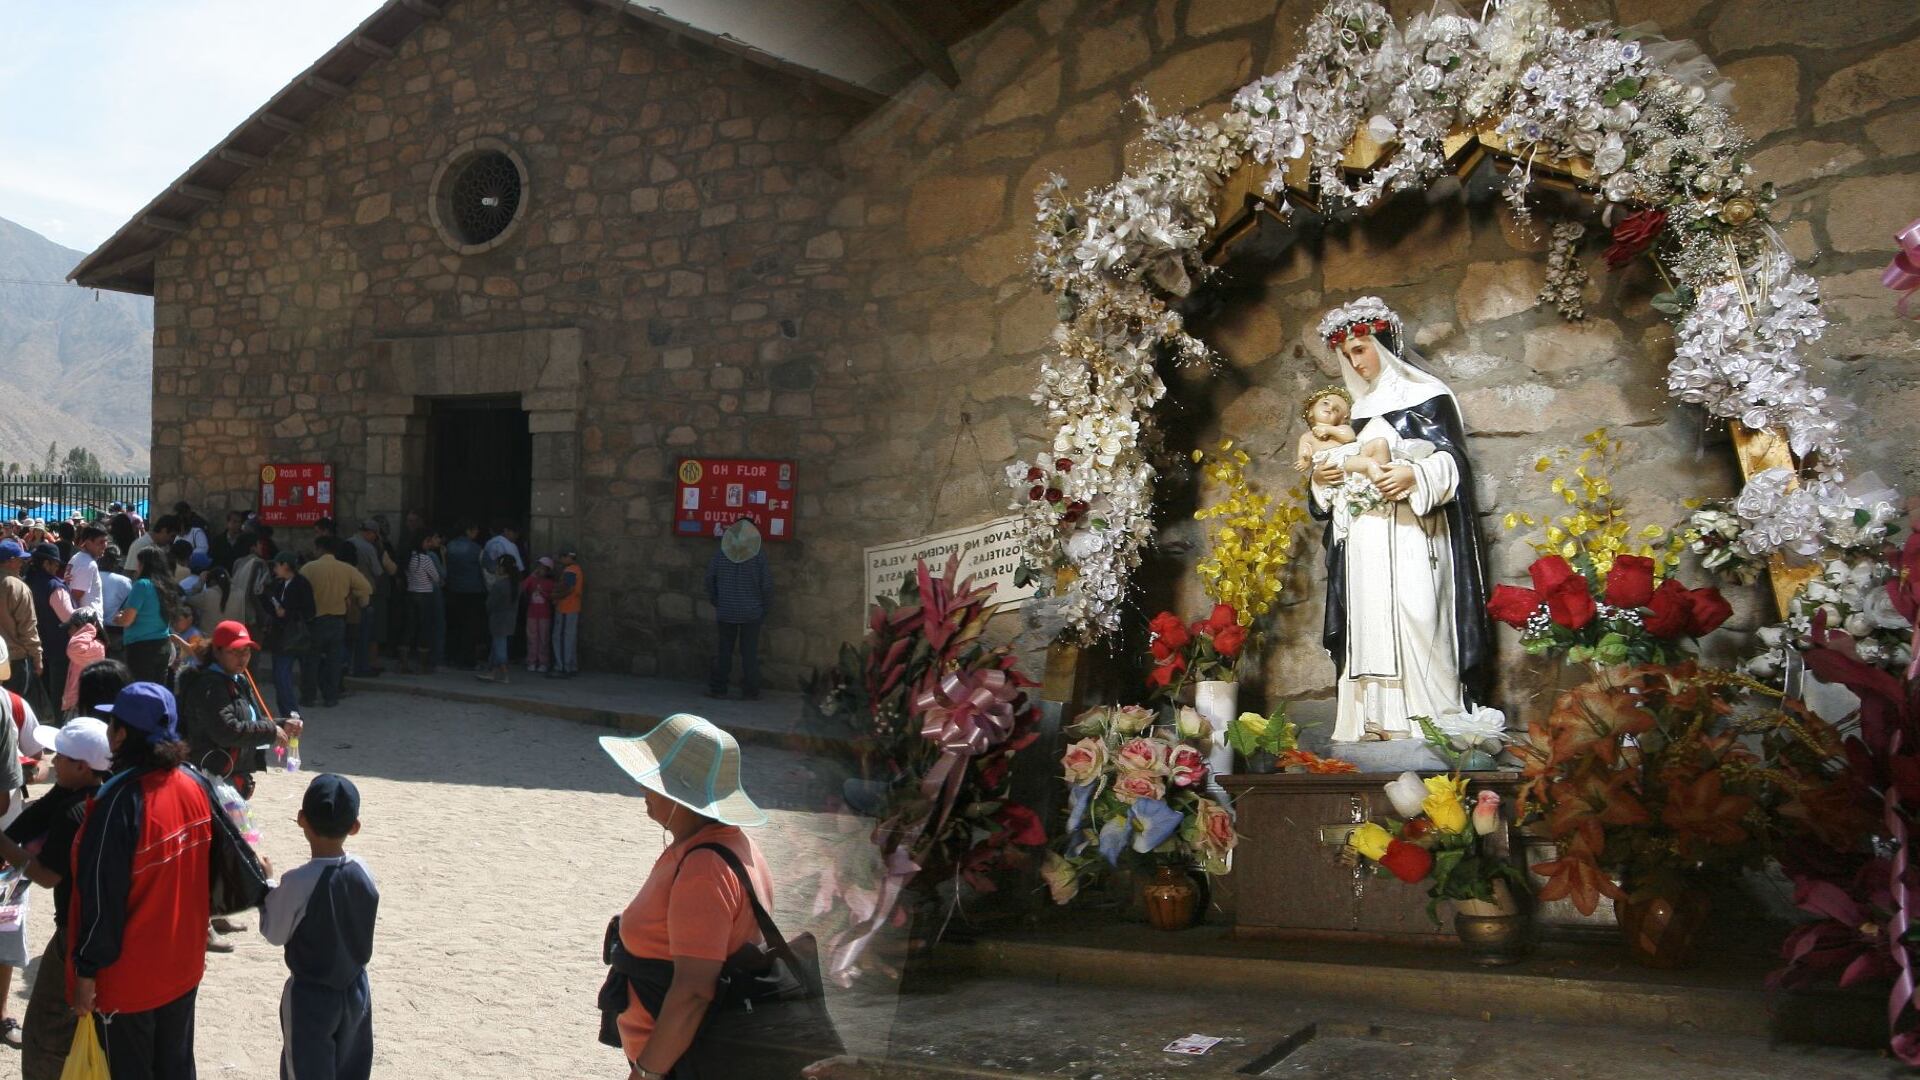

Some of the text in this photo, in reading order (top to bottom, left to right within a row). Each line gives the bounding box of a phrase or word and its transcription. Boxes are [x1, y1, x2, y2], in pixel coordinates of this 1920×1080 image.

[280, 469, 312, 478] ROSA DE
[712, 464, 728, 476] OH
[737, 464, 767, 477] FLOR
